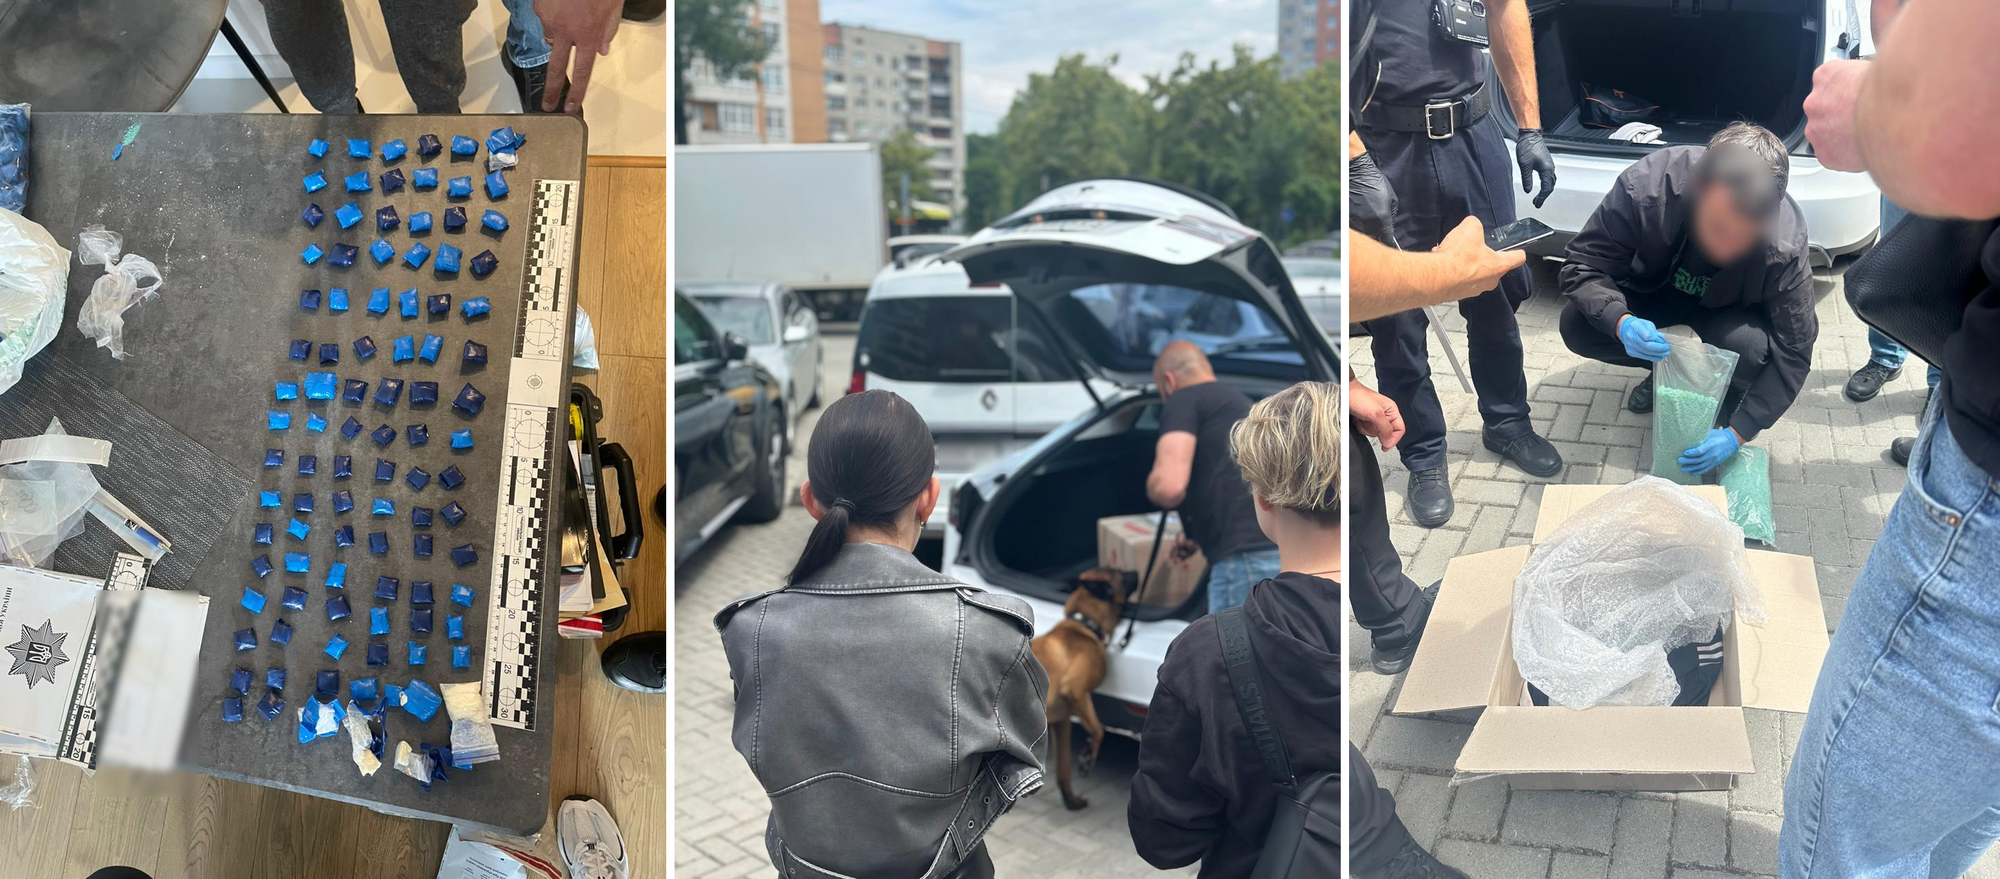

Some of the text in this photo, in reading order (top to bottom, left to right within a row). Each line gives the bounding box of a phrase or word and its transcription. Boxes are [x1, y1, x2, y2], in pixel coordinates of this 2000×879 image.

[509, 610, 516, 619] 20
[504, 664, 512, 674] 25
[83, 710, 90, 719] 15
[500, 708, 508, 718] 30
[73, 747, 80, 758] 20
